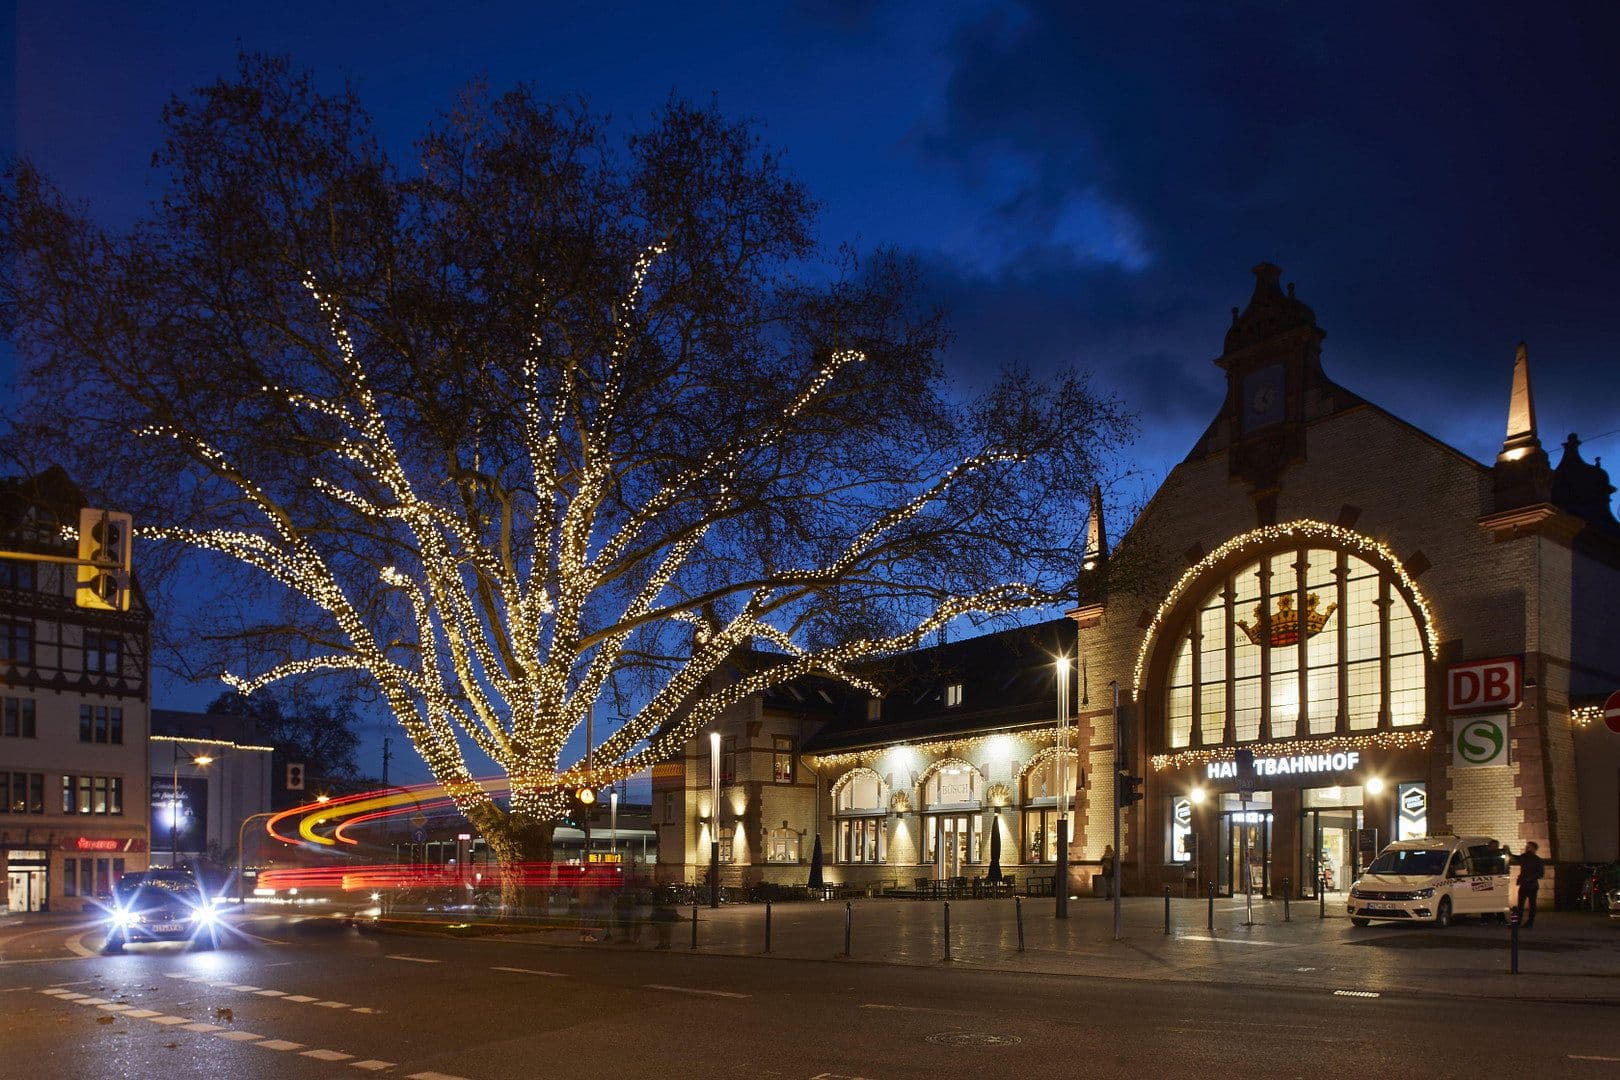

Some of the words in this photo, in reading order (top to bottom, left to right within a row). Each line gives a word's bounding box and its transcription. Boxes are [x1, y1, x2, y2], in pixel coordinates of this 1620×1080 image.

[1453, 667, 1511, 706] DB
[1463, 722, 1497, 762] S
[1207, 752, 1360, 779] HATBAHNHOF
